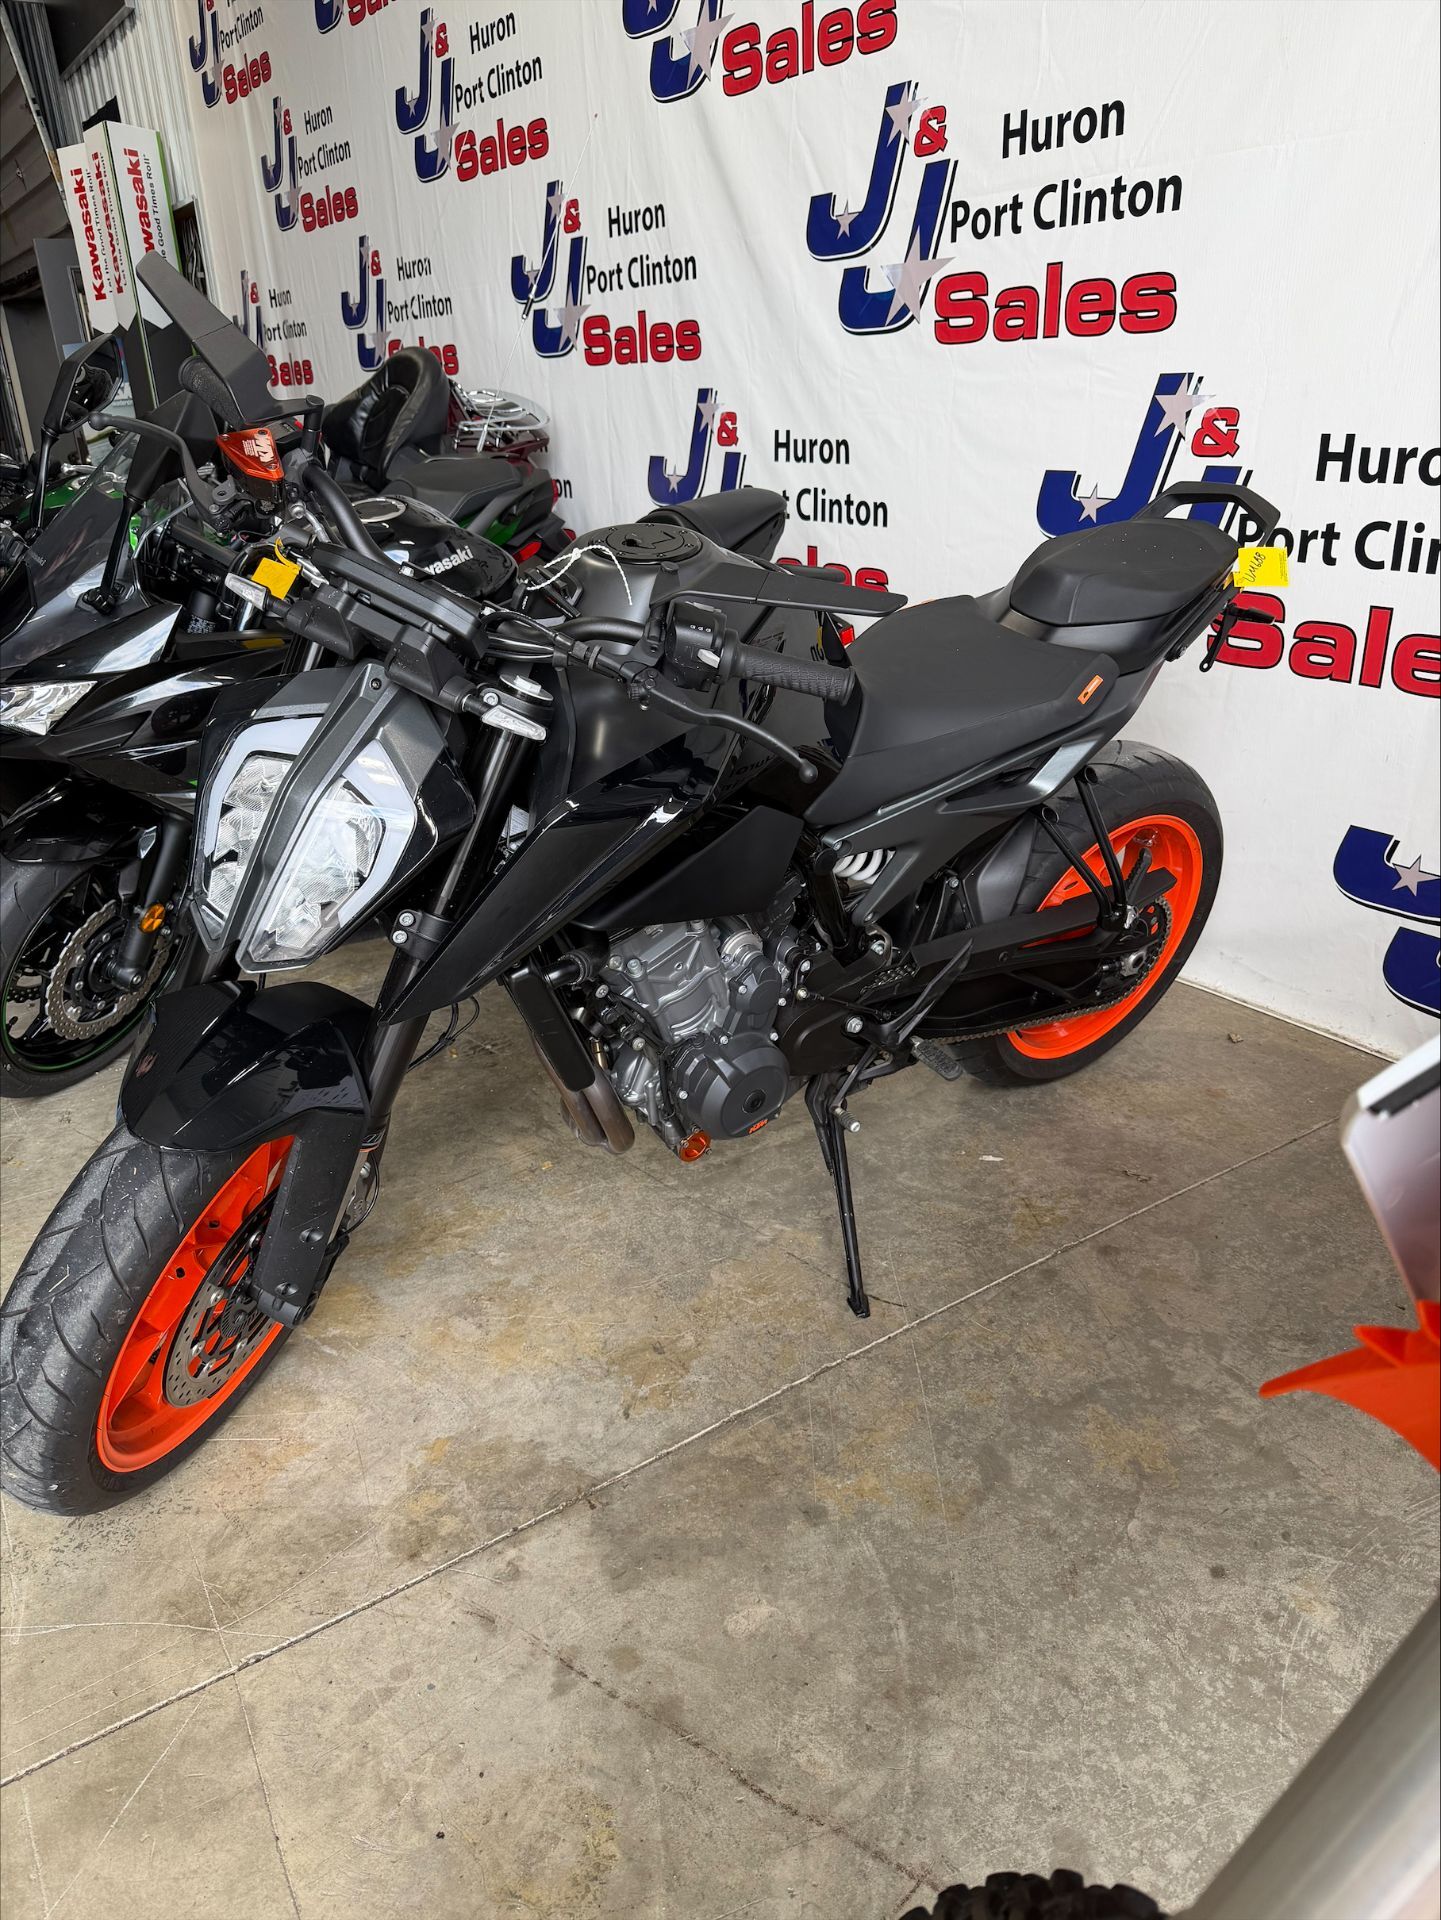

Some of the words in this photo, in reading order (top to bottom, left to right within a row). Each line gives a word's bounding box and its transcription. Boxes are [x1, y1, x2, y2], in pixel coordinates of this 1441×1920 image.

[219, 27, 240, 52] Port
[236, 6, 264, 43] Clinton
[469, 11, 516, 55] Huron
[722, 0, 898, 97] Sales
[223, 51, 272, 104] Sales
[455, 76, 485, 113] Port
[486, 55, 543, 99] Clinton
[303, 105, 334, 135] Huron
[1001, 99, 1126, 159] Huron
[144, 156, 154, 180] Roll
[298, 153, 317, 179] Port
[316, 140, 352, 170] Clinton
[454, 117, 550, 182] Sales
[123, 148, 155, 253] wasaki
[149, 182, 160, 217] Times
[300, 185, 359, 233] Sales
[607, 203, 666, 238] Huron
[950, 193, 1024, 244] Port
[1032, 174, 1184, 230] Clinton
[70, 168, 107, 301] Kawasaki
[91, 152, 124, 294] Kawasaki
[156, 217, 166, 248] Good
[396, 256, 432, 281] Huron
[586, 262, 624, 295] Port
[627, 253, 697, 289] Clinton
[268, 288, 292, 309] Huon
[387, 300, 410, 324] Port
[410, 295, 453, 320] Clinton
[933, 261, 1178, 345] Sales
[582, 310, 702, 367] Sales
[773, 429, 851, 465] Huron
[795, 488, 889, 528] Clinton
[1238, 513, 1341, 567] Port
